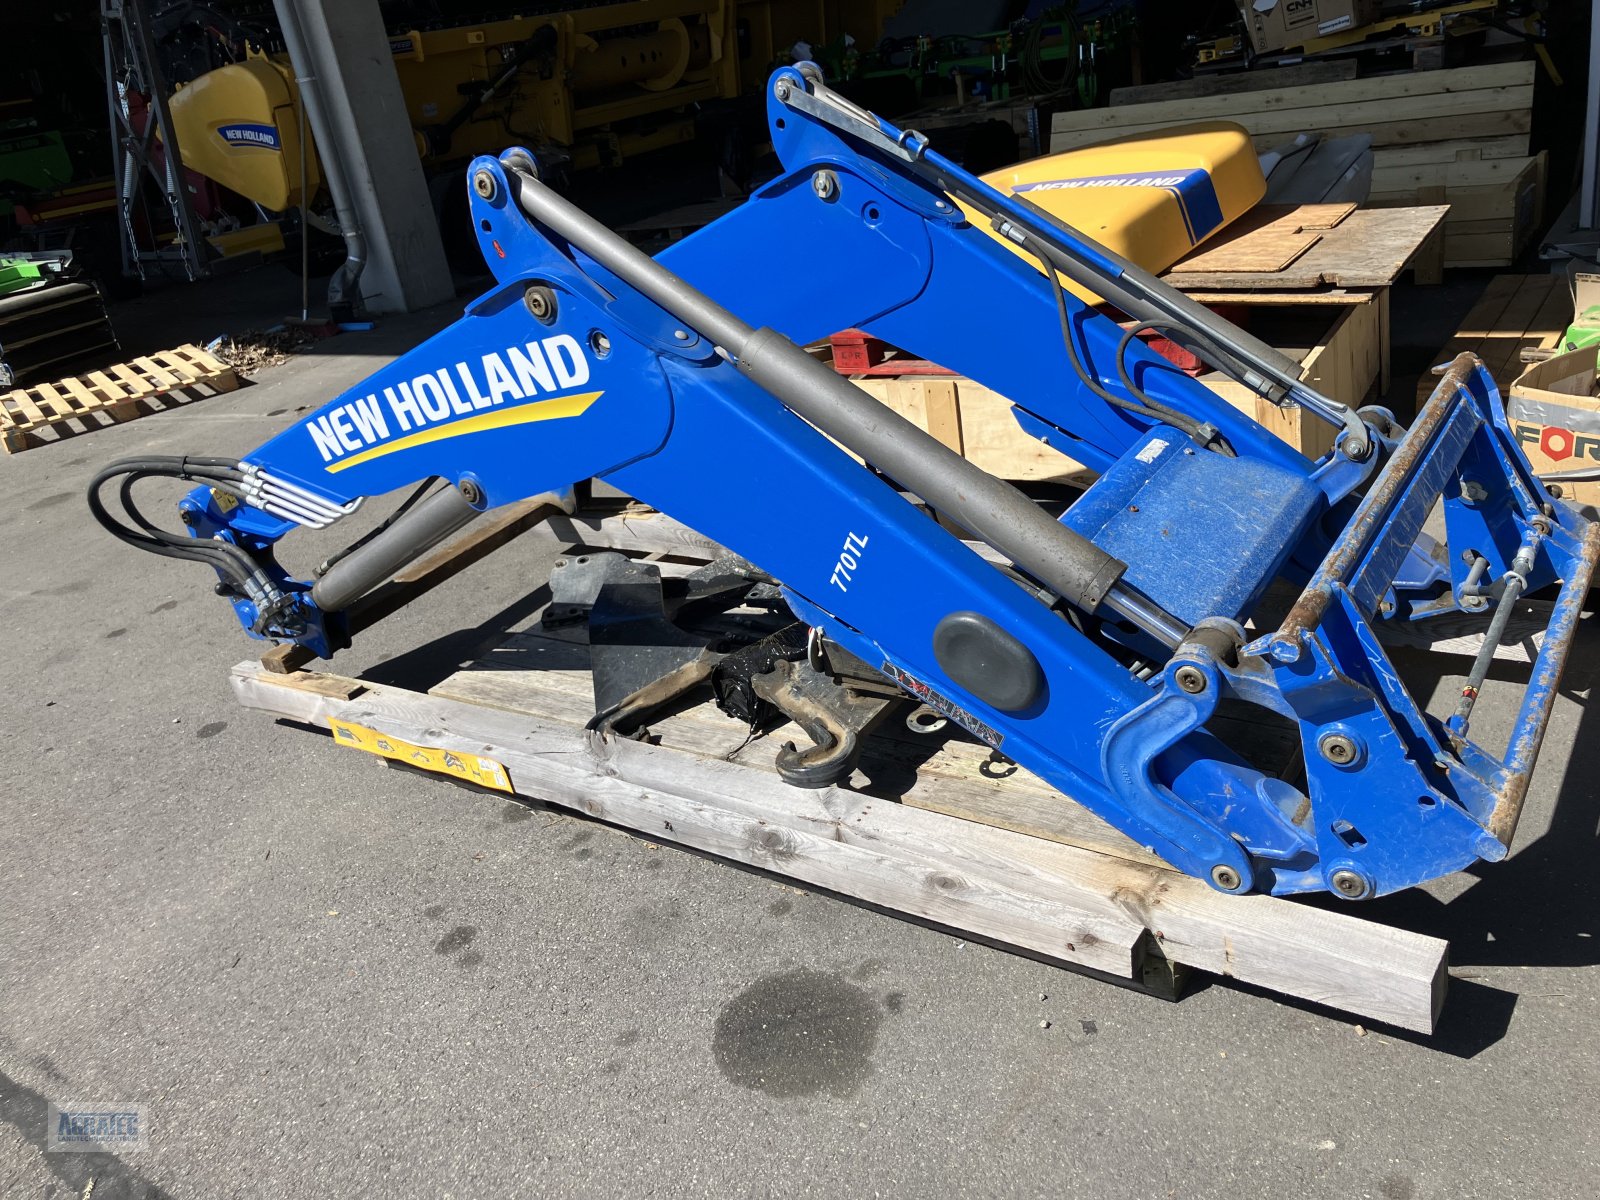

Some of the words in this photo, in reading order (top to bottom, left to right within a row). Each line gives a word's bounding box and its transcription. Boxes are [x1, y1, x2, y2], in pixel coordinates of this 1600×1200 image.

[1286, 0, 1312, 12] CNH
[225, 129, 242, 139] NEW
[243, 130, 274, 145] HOLLAND
[1029, 180, 1082, 191] NEW
[1084, 176, 1186, 188] HOLLAND
[306, 394, 390, 462] NEW
[383, 334, 590, 431] HOLLAND
[829, 531, 869, 593] 770TL
